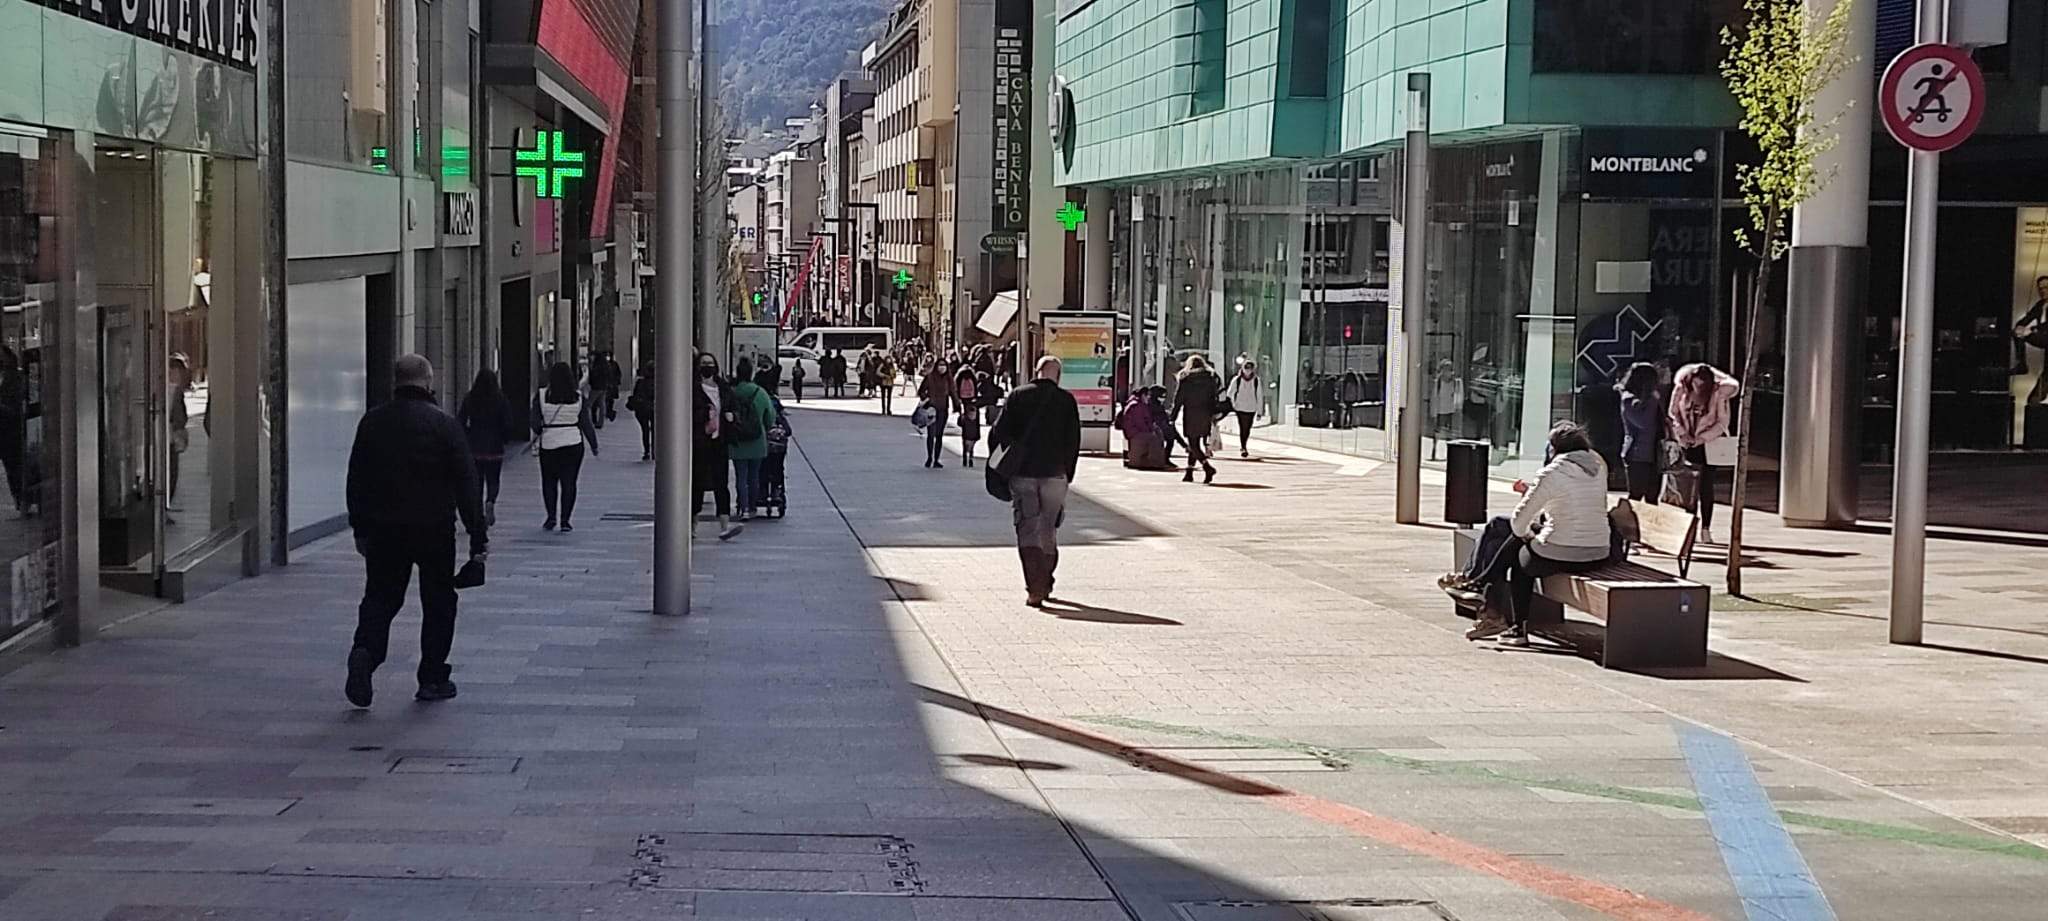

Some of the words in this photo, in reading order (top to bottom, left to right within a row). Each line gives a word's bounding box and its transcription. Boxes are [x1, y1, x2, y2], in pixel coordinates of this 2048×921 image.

[66, 0, 260, 67] MERIES
[1011, 77, 1023, 131] CAVA
[1009, 142, 1022, 222] BENITO
[1590, 156, 1694, 172] MONTBLANC
[449, 192, 475, 235] MANGO
